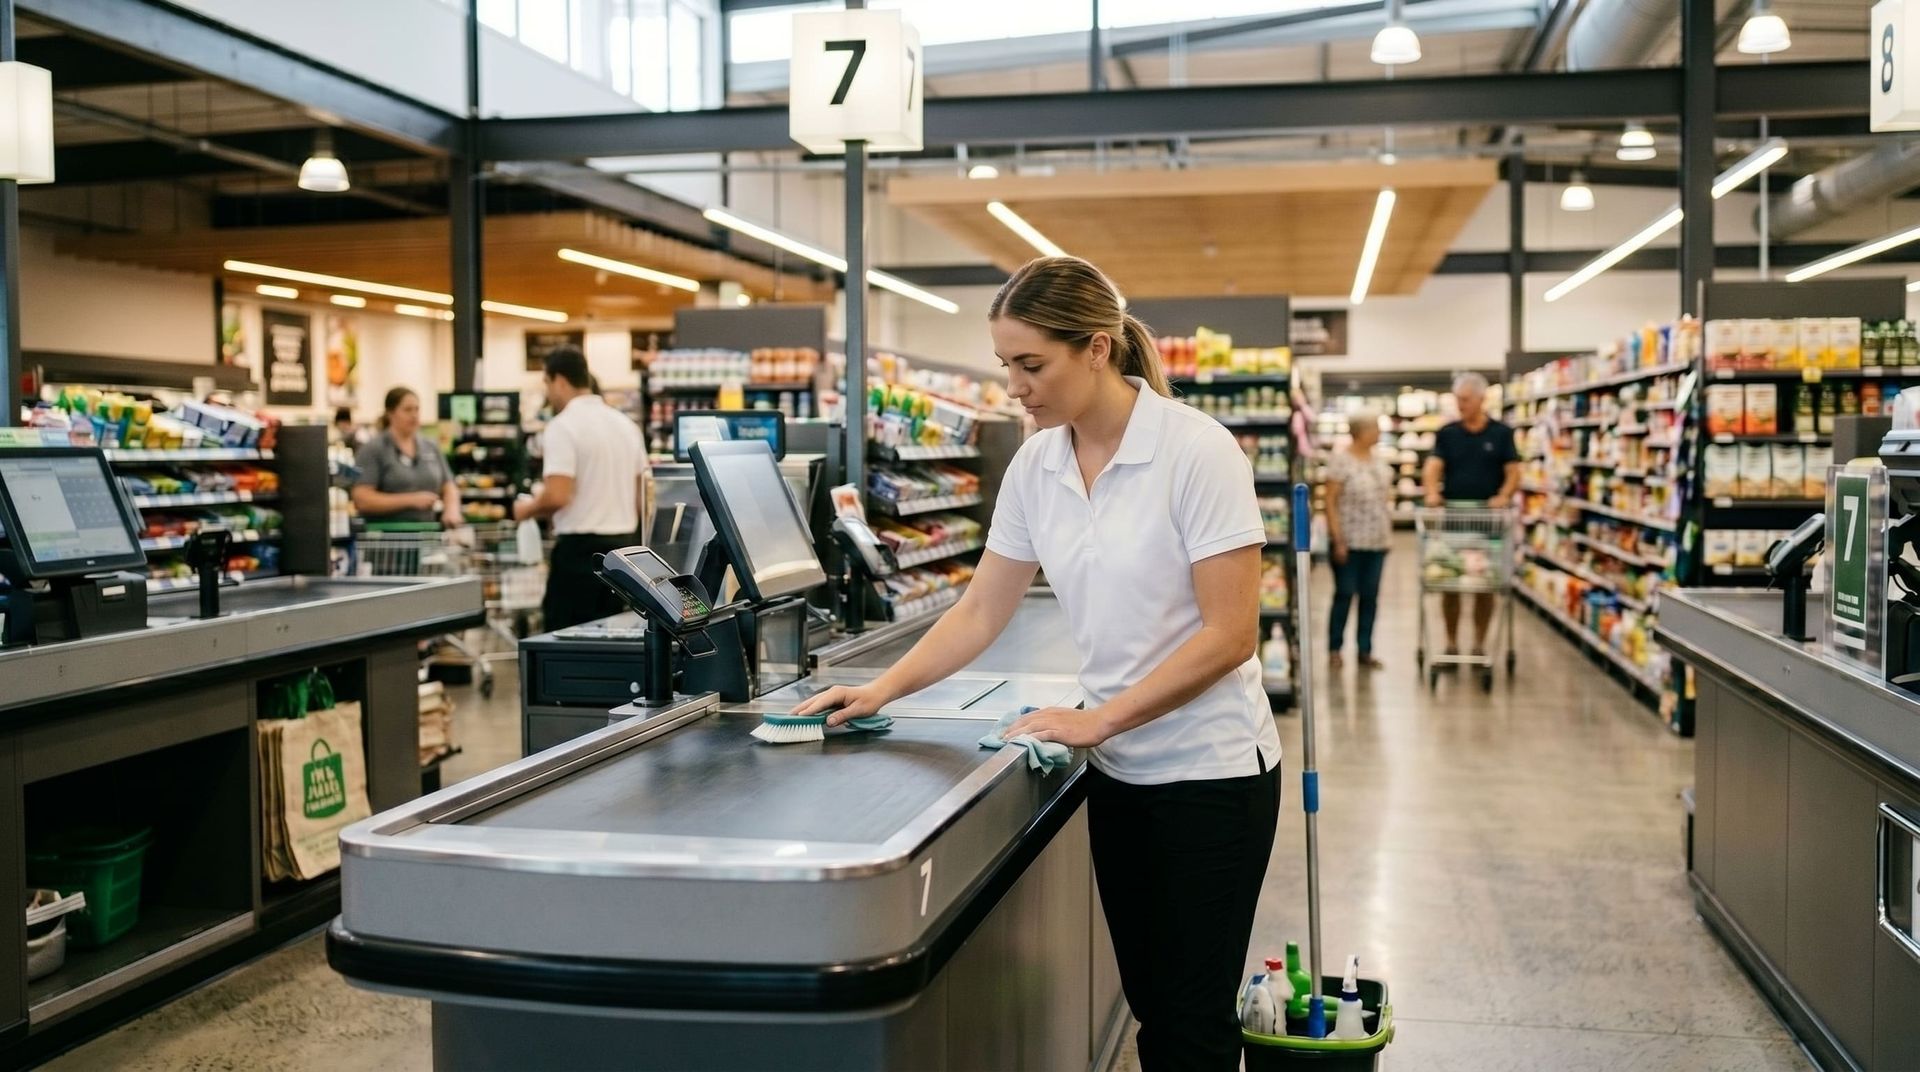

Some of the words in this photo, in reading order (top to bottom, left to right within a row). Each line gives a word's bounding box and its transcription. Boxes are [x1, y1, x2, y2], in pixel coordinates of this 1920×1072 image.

[825, 39, 867, 105] 7
[1882, 23, 1894, 93] 8
[1843, 495, 1859, 562] 7
[921, 857, 933, 916] 7
